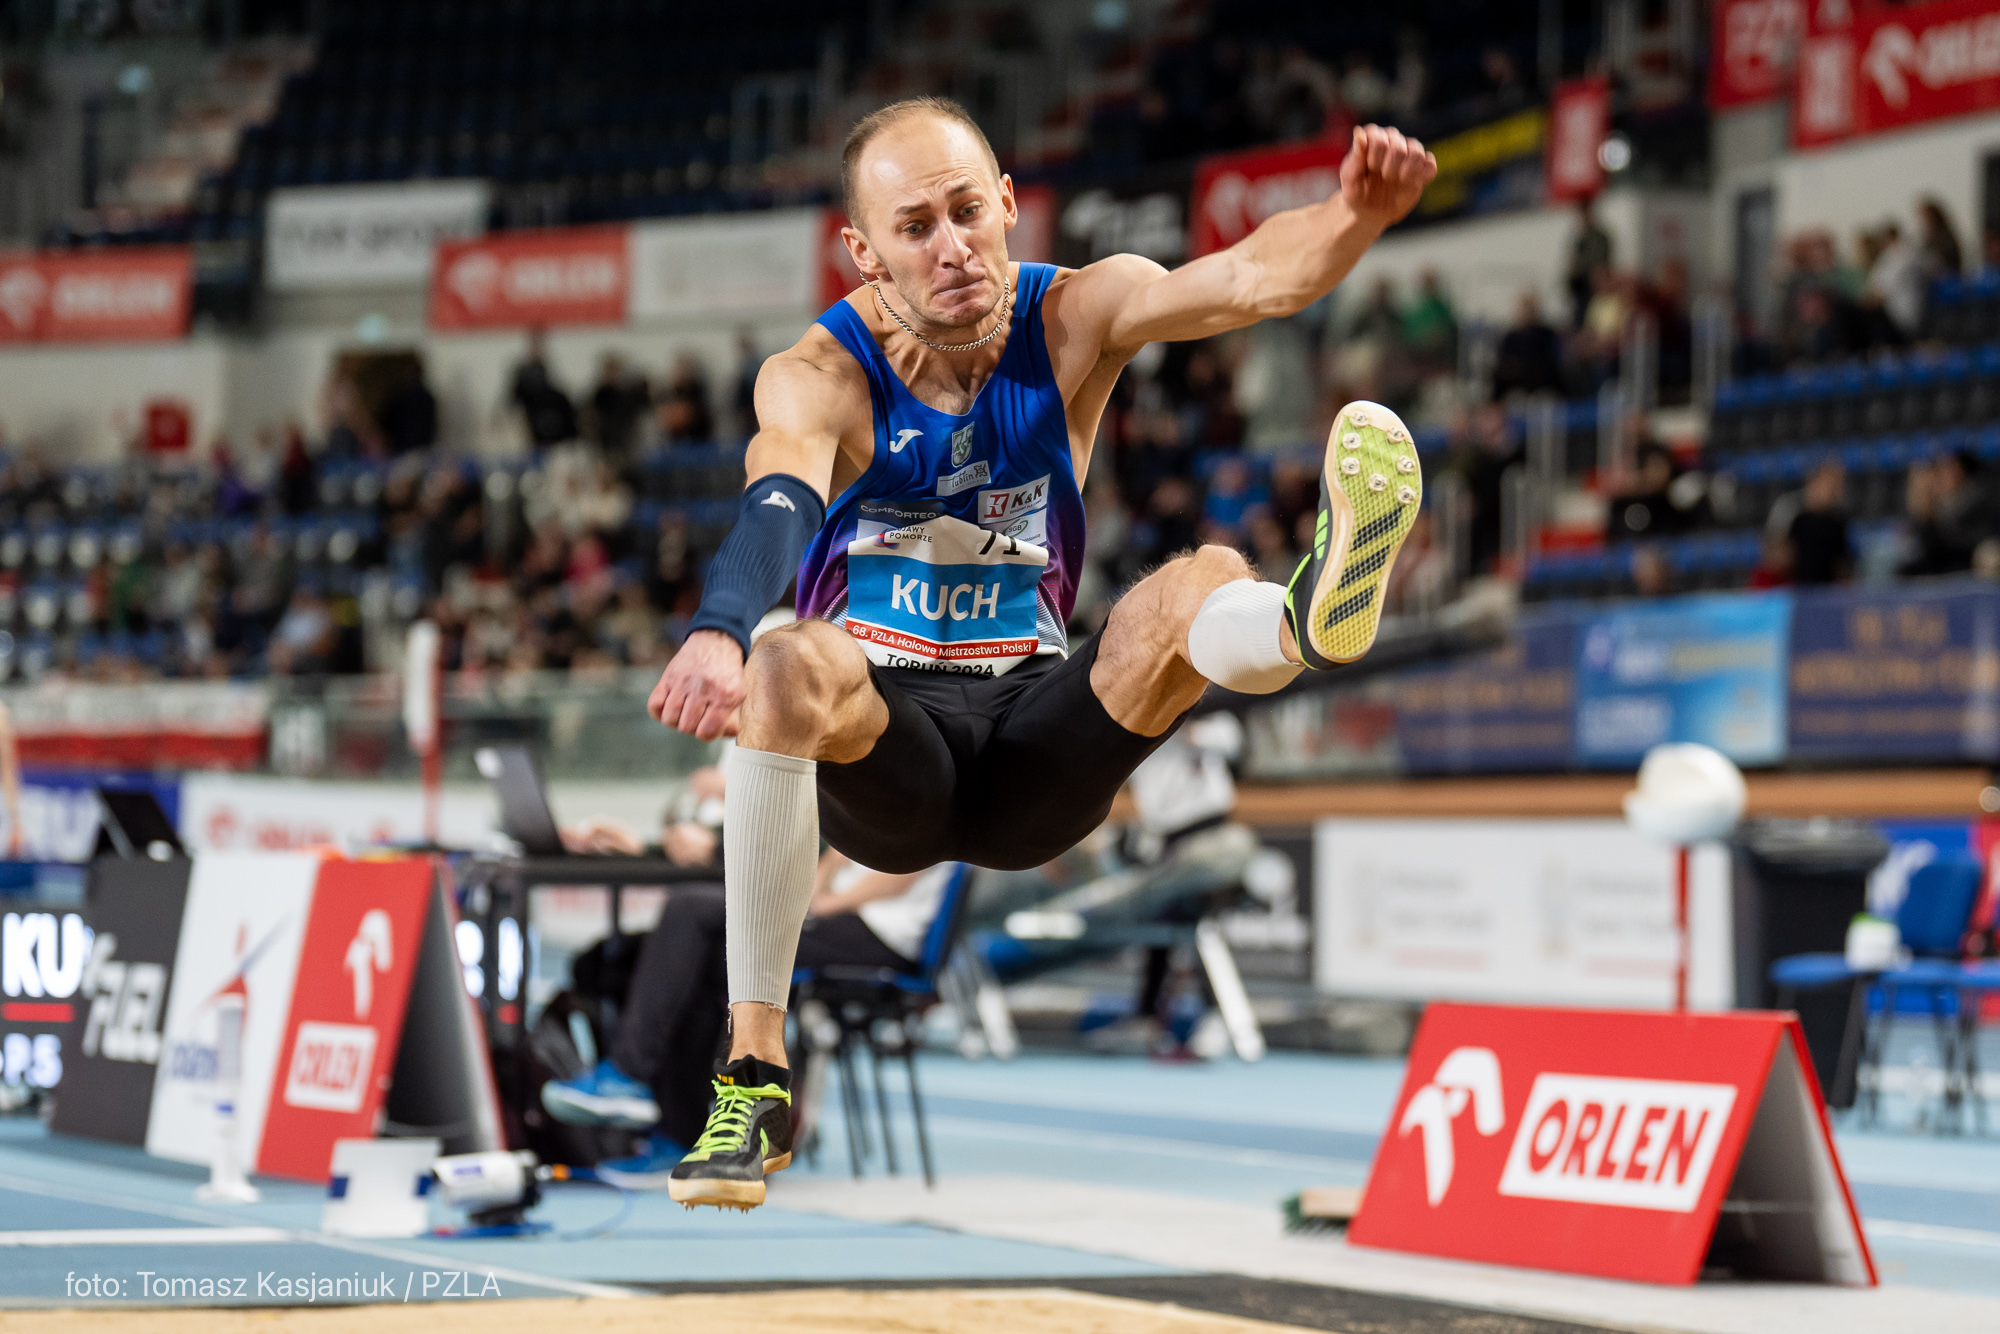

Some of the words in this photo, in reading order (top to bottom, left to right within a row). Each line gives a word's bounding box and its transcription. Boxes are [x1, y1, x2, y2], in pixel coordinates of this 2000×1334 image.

[889, 532, 933, 543] POMORZE
[891, 574, 1001, 621] KUCH
[852, 625, 868, 638] 68.
[870, 629, 895, 644] PZLA
[896, 636, 937, 655] Halowe
[938, 645, 1000, 657] Mistrzostwa
[1001, 642, 1032, 654] Polski
[1528, 1099, 1710, 1185] ORLEN
